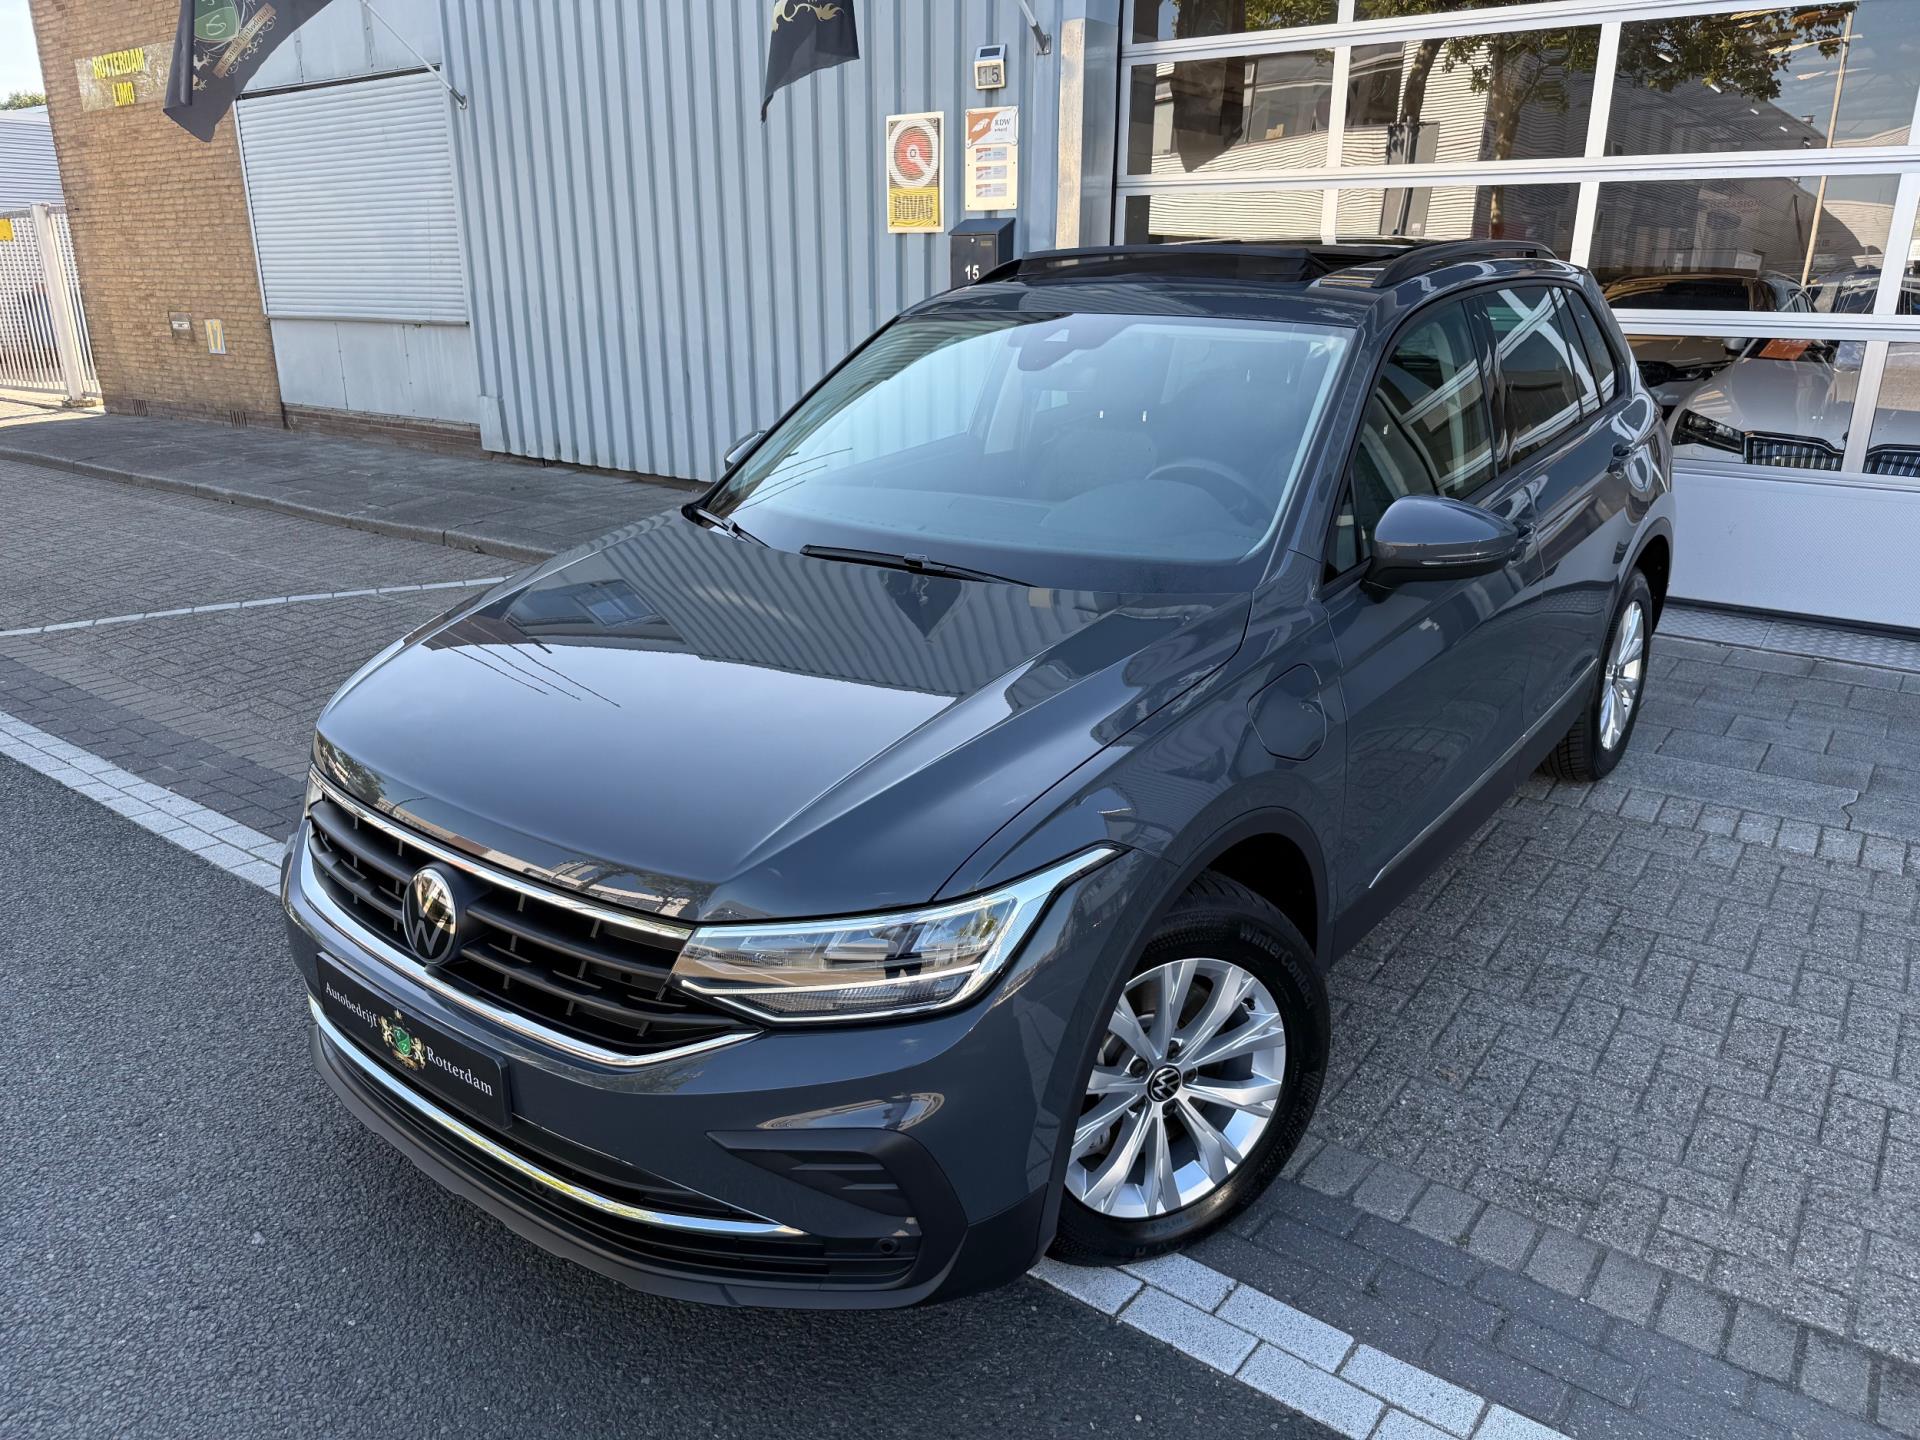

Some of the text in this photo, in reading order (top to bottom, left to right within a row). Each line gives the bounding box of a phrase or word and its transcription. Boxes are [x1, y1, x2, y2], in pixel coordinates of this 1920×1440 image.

[92, 47, 145, 79] ROTTERDAM
[982, 67, 999, 84] 15
[112, 81, 135, 107] LIMO
[894, 195, 933, 220] BOVAG
[965, 264, 980, 280] 15
[326, 982, 493, 1097] Autobedrijf Rotterdam
